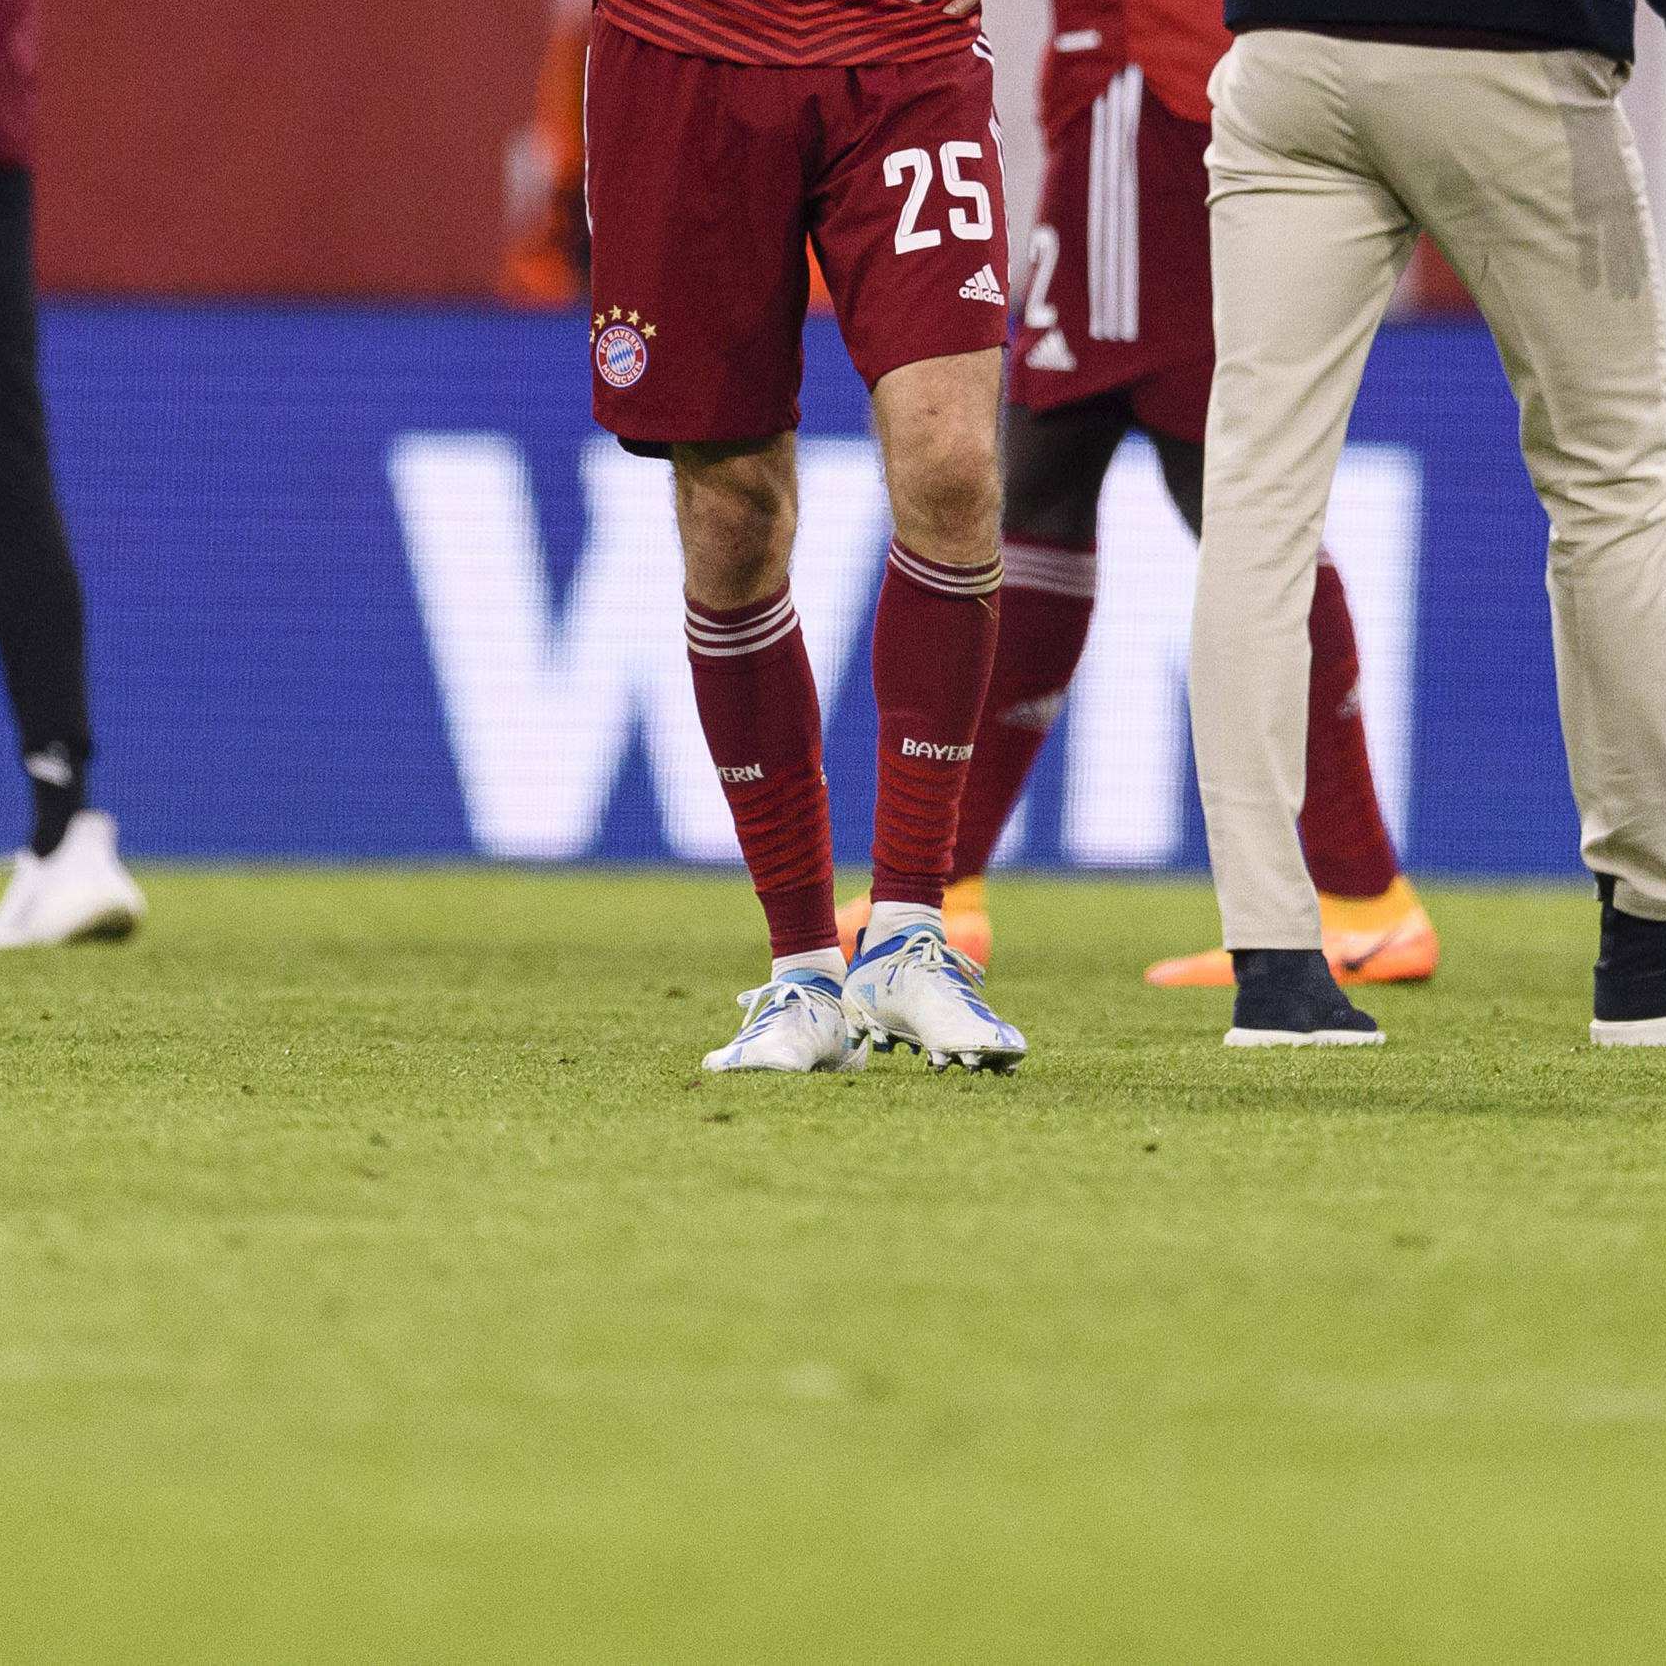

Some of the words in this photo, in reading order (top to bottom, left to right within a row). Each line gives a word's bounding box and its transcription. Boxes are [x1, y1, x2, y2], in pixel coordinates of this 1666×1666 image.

[883, 141, 993, 255] 25
[959, 286, 1005, 306] adidas
[608, 330, 641, 351] BAYERN
[901, 737, 975, 761] BAYERN
